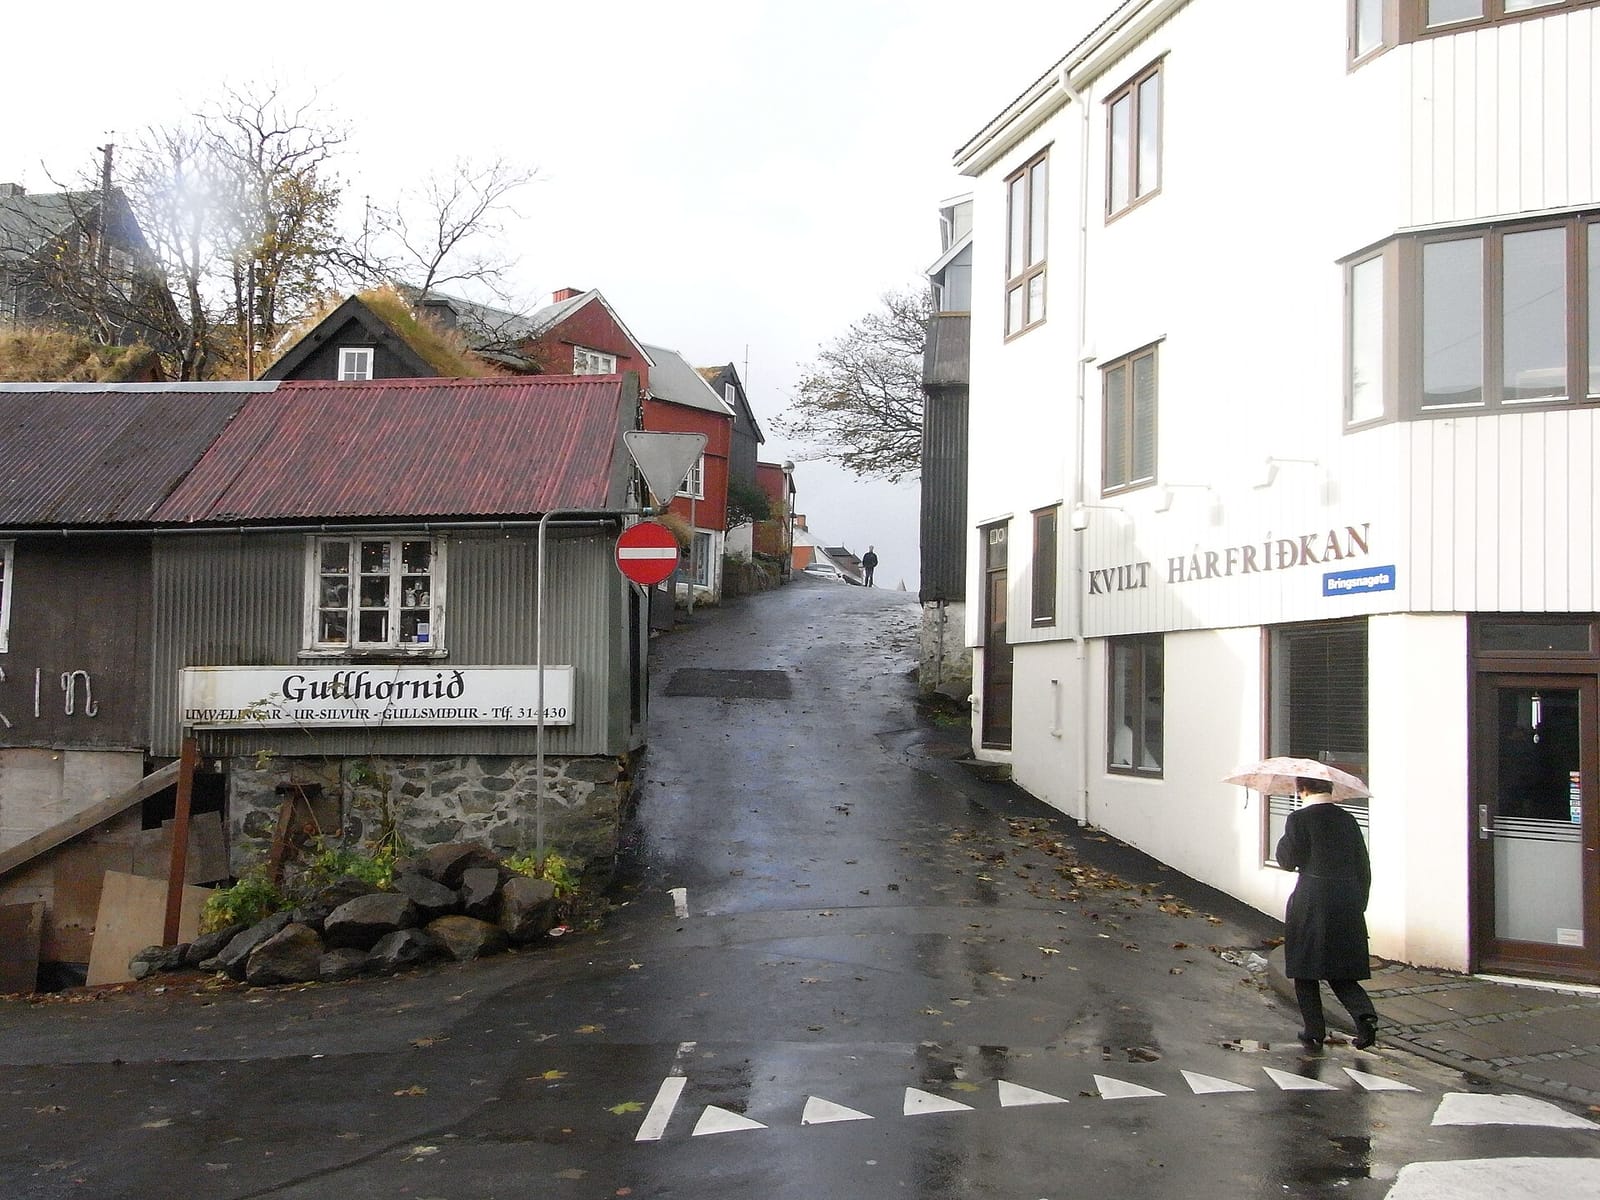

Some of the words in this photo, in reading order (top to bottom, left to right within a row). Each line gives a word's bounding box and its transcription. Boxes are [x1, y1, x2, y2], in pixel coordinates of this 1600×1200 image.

[1088, 561, 1151, 595] KVILT
[282, 670, 465, 702] Gullhornið
[294, 709, 370, 720] UR-SILVUR
